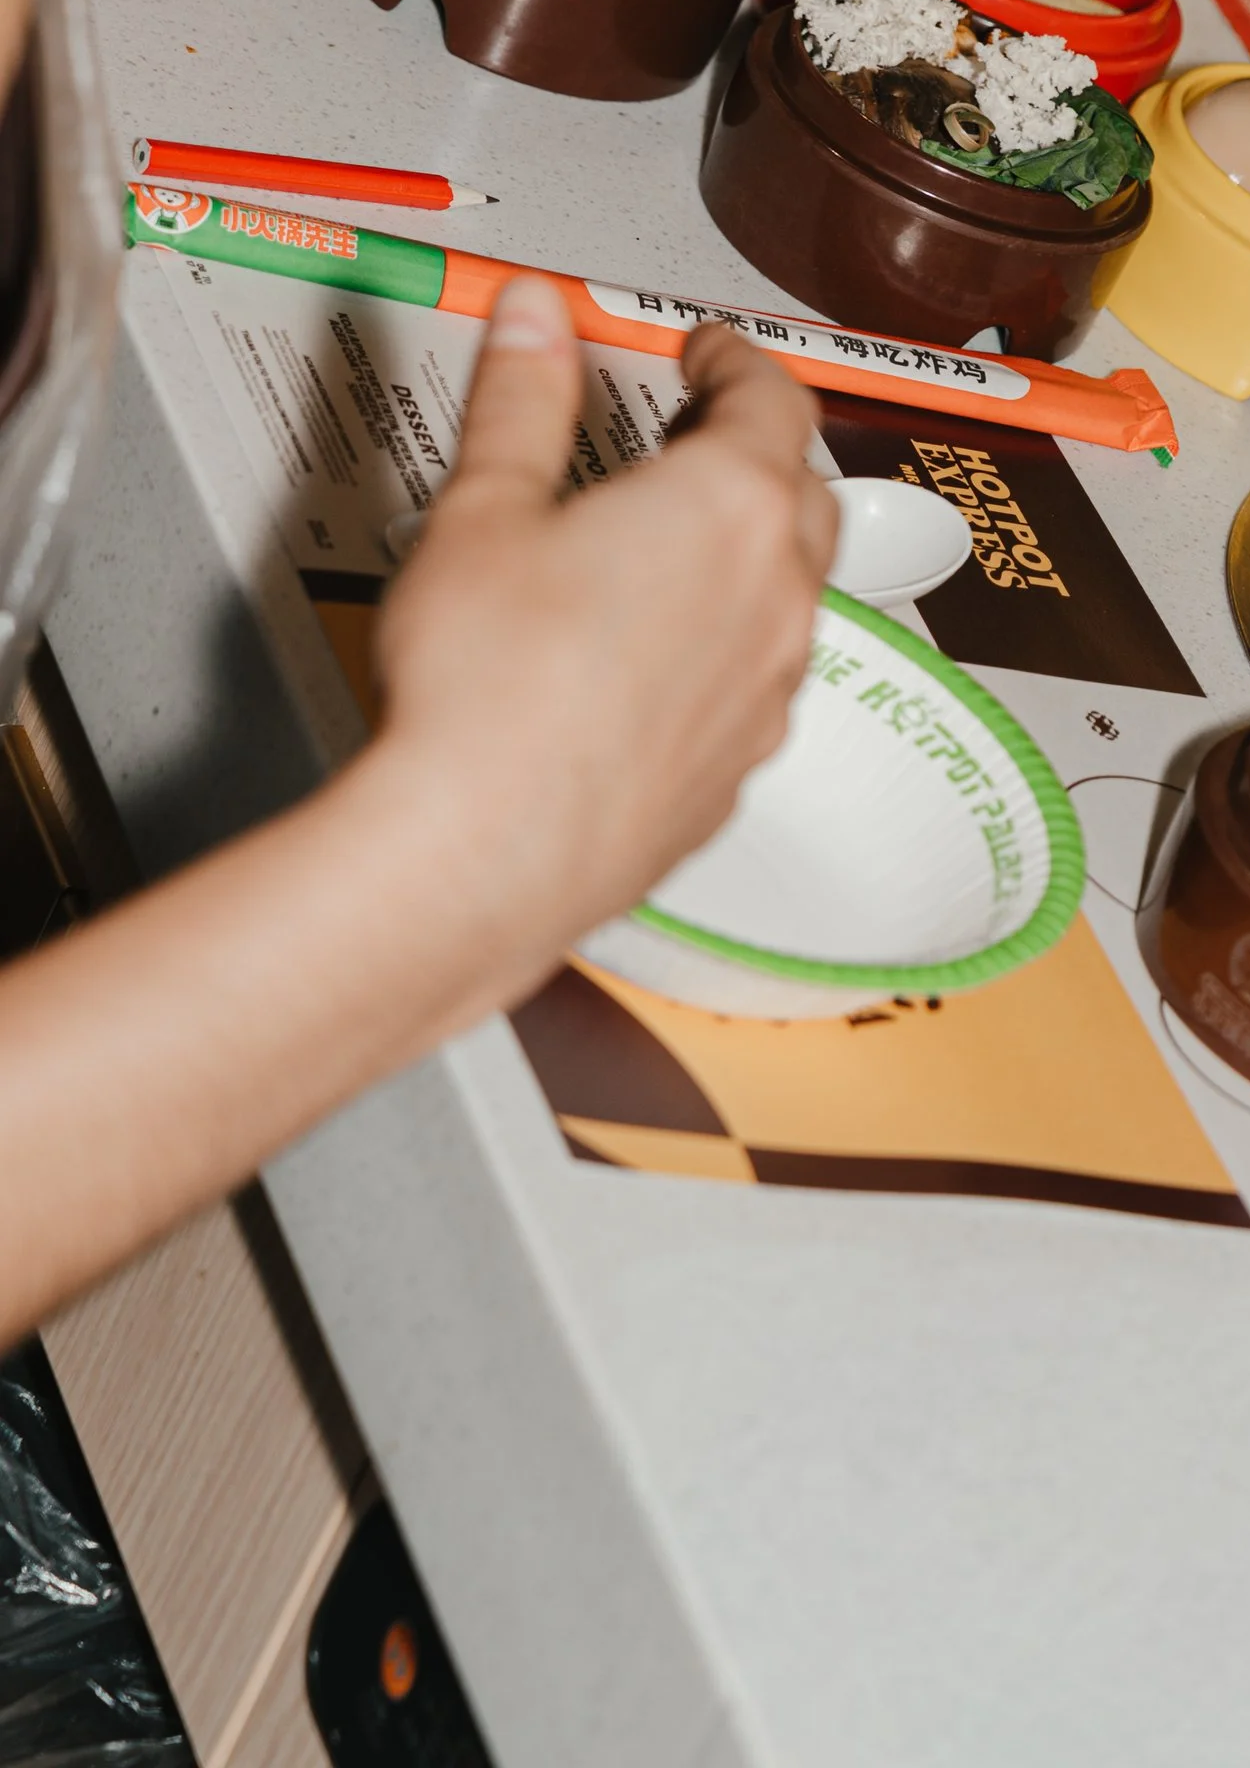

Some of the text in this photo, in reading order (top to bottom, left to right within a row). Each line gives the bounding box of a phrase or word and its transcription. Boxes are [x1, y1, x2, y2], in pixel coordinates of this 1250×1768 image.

[220, 204, 358, 259] 小火锅先生
[190, 269, 203, 283] MAY
[240, 329, 256, 351] THANK
[251, 353, 263, 366] YOU
[597, 369, 622, 400] CURED
[636, 384, 663, 418] KIMCHI
[336, 312, 431, 495] KOJI APPLE TARTE TATIN, SPENT BEER
[390, 384, 447, 468] DESSERT
[608, 413, 632, 444] SHISO,
[379, 429, 407, 470] SMOKED
[604, 428, 630, 462] SIMONE
[899, 463, 919, 482] MR
[909, 439, 1028, 588] EXPRESS
[951, 447, 1069, 596] HOTPOT
